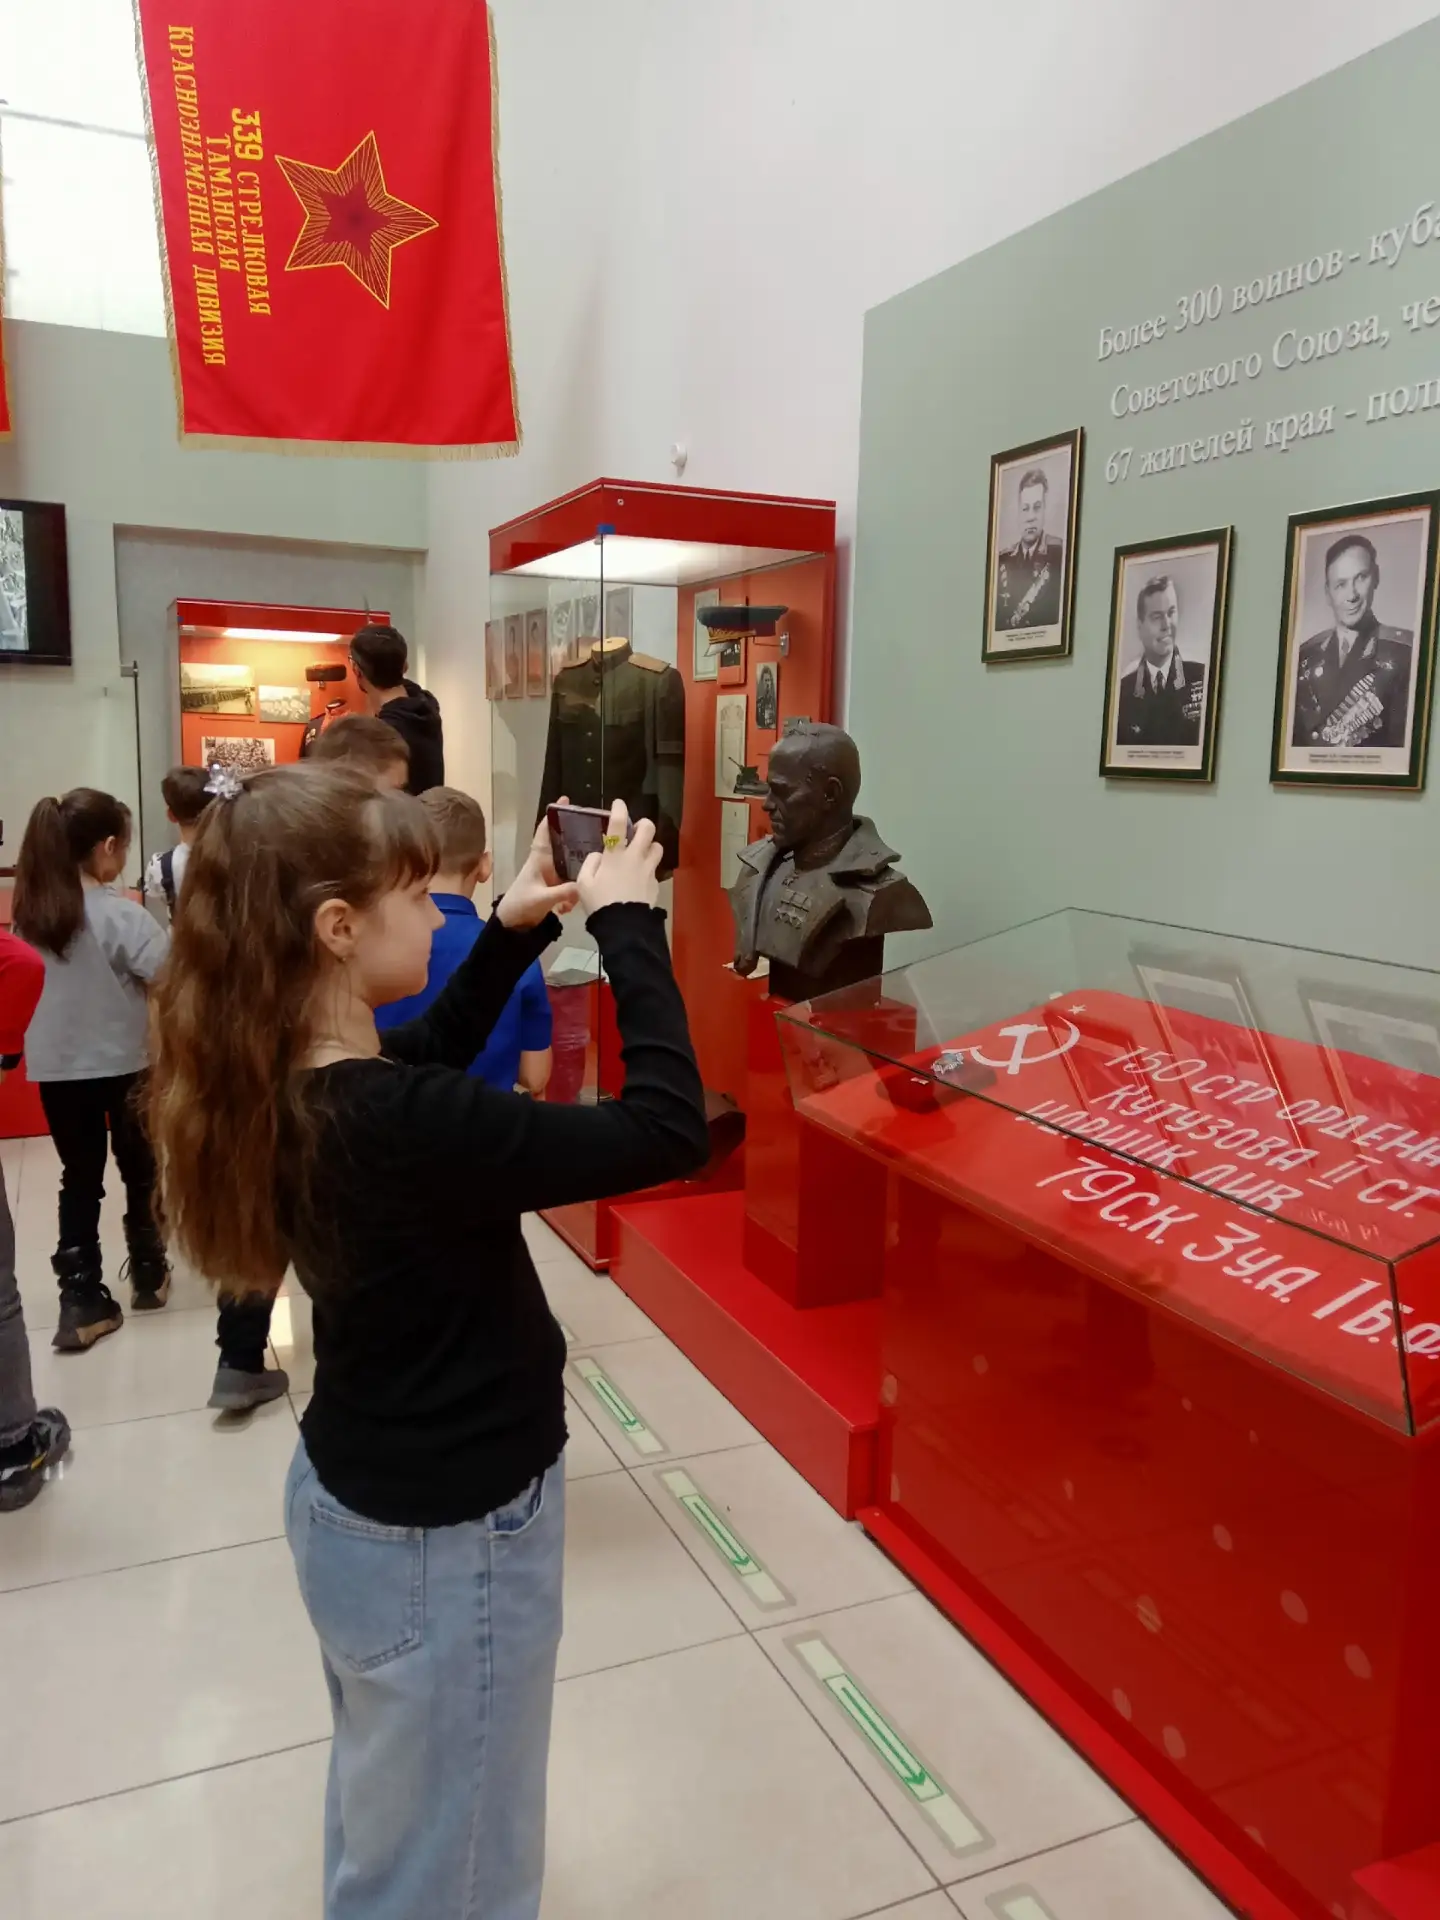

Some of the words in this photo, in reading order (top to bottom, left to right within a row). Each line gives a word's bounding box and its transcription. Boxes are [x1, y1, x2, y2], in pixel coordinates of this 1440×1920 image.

[231, 107, 264, 161] 339
[168, 24, 216, 256] КРАСНОЗНАМЕННАЯ
[192, 264, 226, 366] ДИВИЗИЯ
[206, 133, 240, 272] ТАМАНСКАЯ
[236, 171, 271, 315] СТРЕЛКОВАЯ
[1098, 315, 1167, 362] Более
[1174, 284, 1223, 333] 300
[1110, 352, 1262, 418] Советского
[1272, 315, 1390, 370] Союза,
[1105, 448, 1133, 485] 67
[1139, 417, 1256, 477] жителей
[1264, 405, 1335, 453] края
[1104, 1045, 1208, 1082] 150
[1089, 1084, 1320, 1171] КУТУЗОВА
[1357, 1178, 1440, 1217] СТ.
